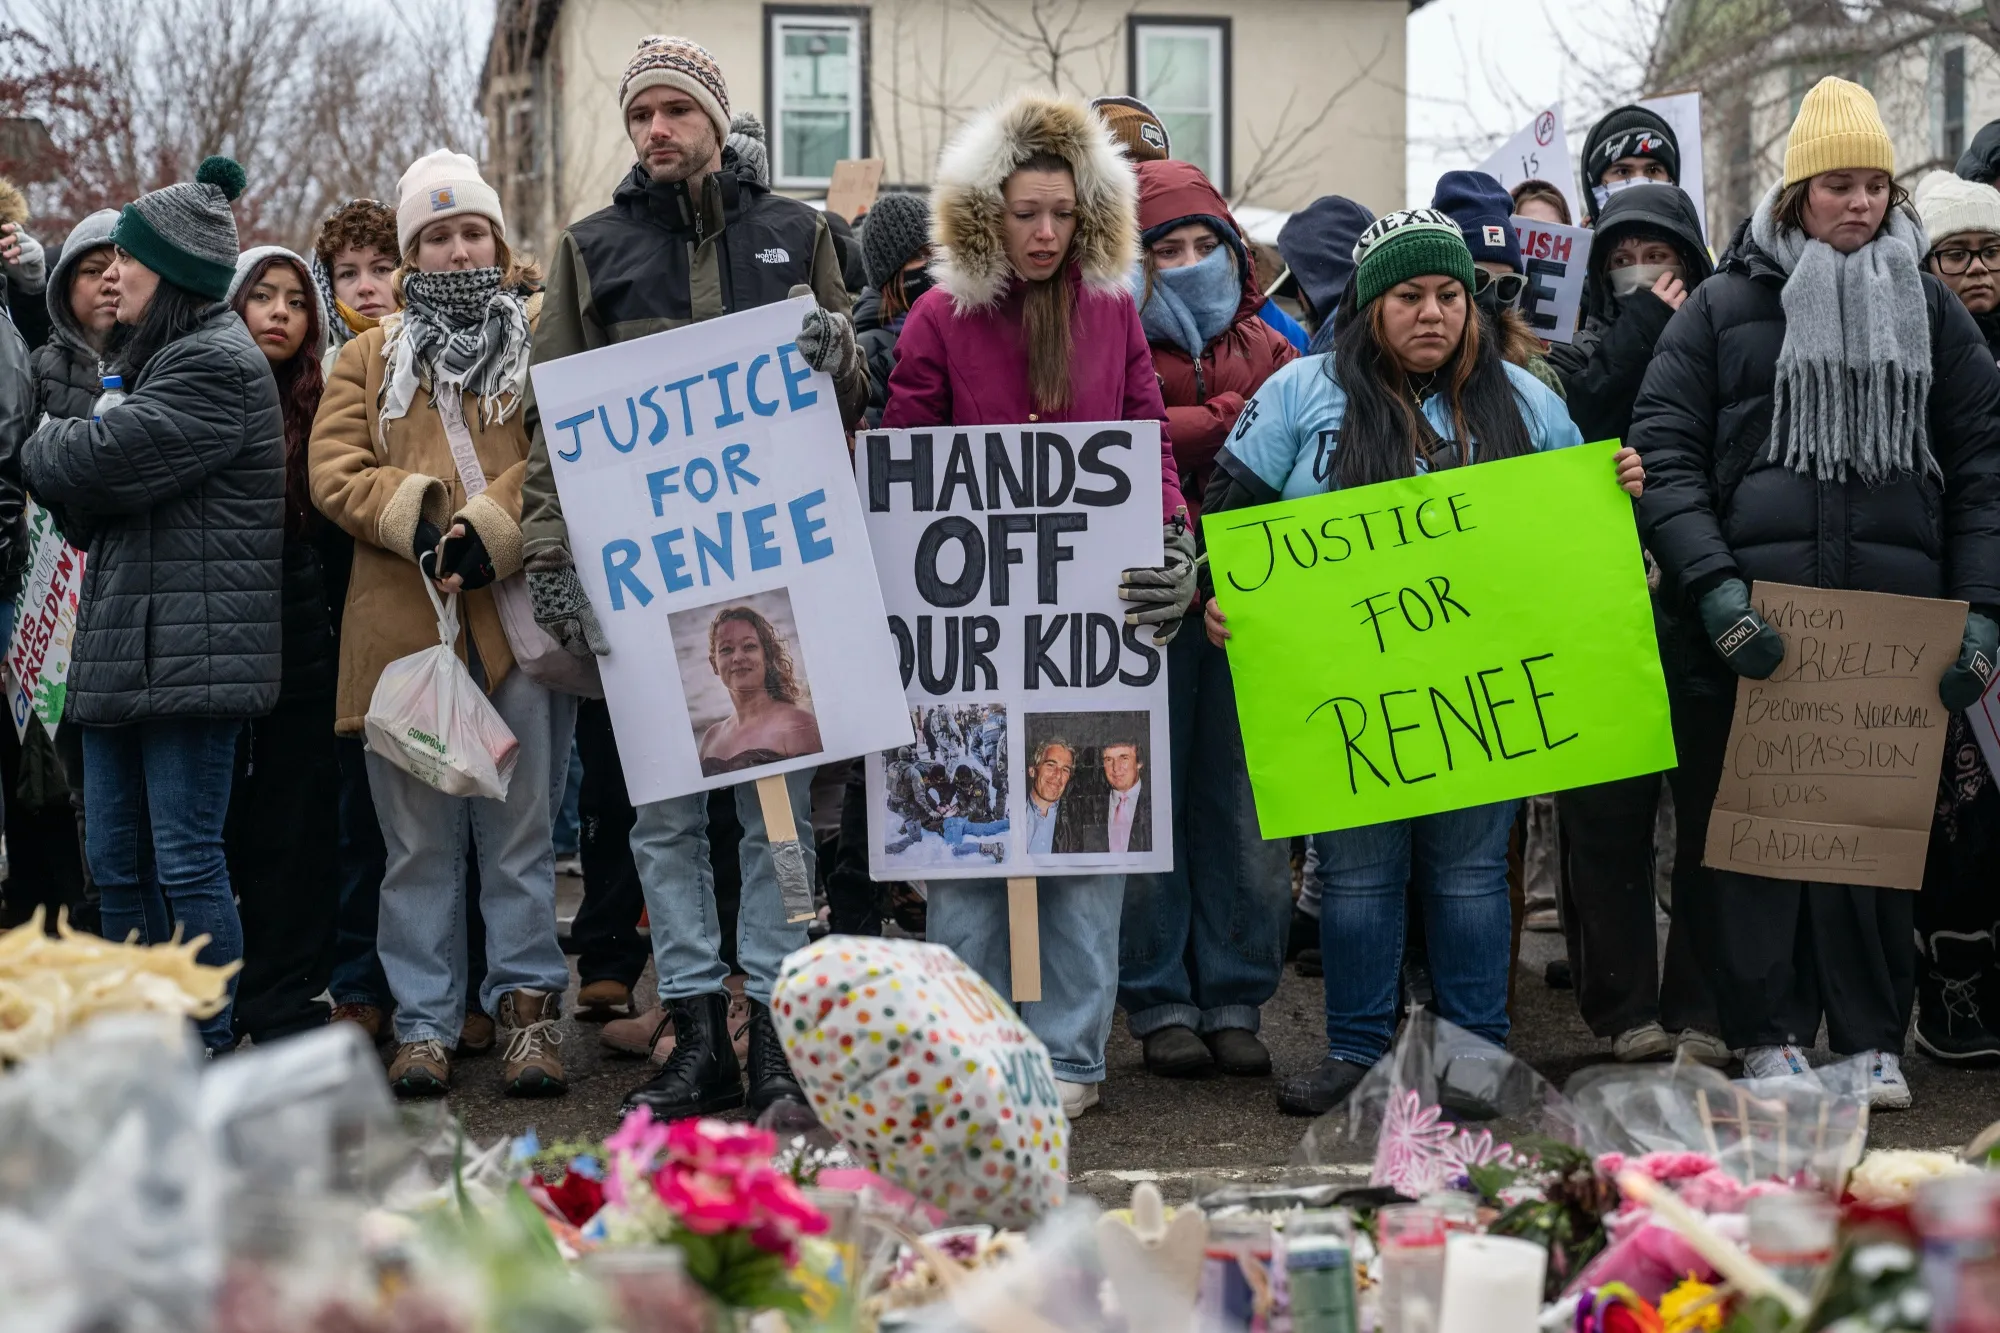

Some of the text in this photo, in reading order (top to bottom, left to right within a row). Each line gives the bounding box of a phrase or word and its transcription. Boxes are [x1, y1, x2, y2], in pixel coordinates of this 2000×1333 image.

[555, 342, 818, 463] JUSTICE
[646, 443, 760, 517] FOR
[866, 430, 1132, 512] HANDS
[602, 488, 835, 612] RENEE
[914, 512, 1087, 608] OFF
[1226, 492, 1478, 592] JUSTICE
[13, 612, 37, 678] MAS
[31, 540, 58, 609] QUE
[1351, 575, 1471, 653] FOR
[1721, 625, 1753, 651] HOWL
[1761, 598, 1844, 630] When
[1023, 612, 1162, 690] KIDS
[1975, 657, 1991, 678] HOW
[1305, 653, 1579, 795] RENEE
[1854, 701, 1935, 728] NORMAL
[1734, 732, 1919, 779] COMPASSION
[1729, 818, 1878, 863] RADICAL
